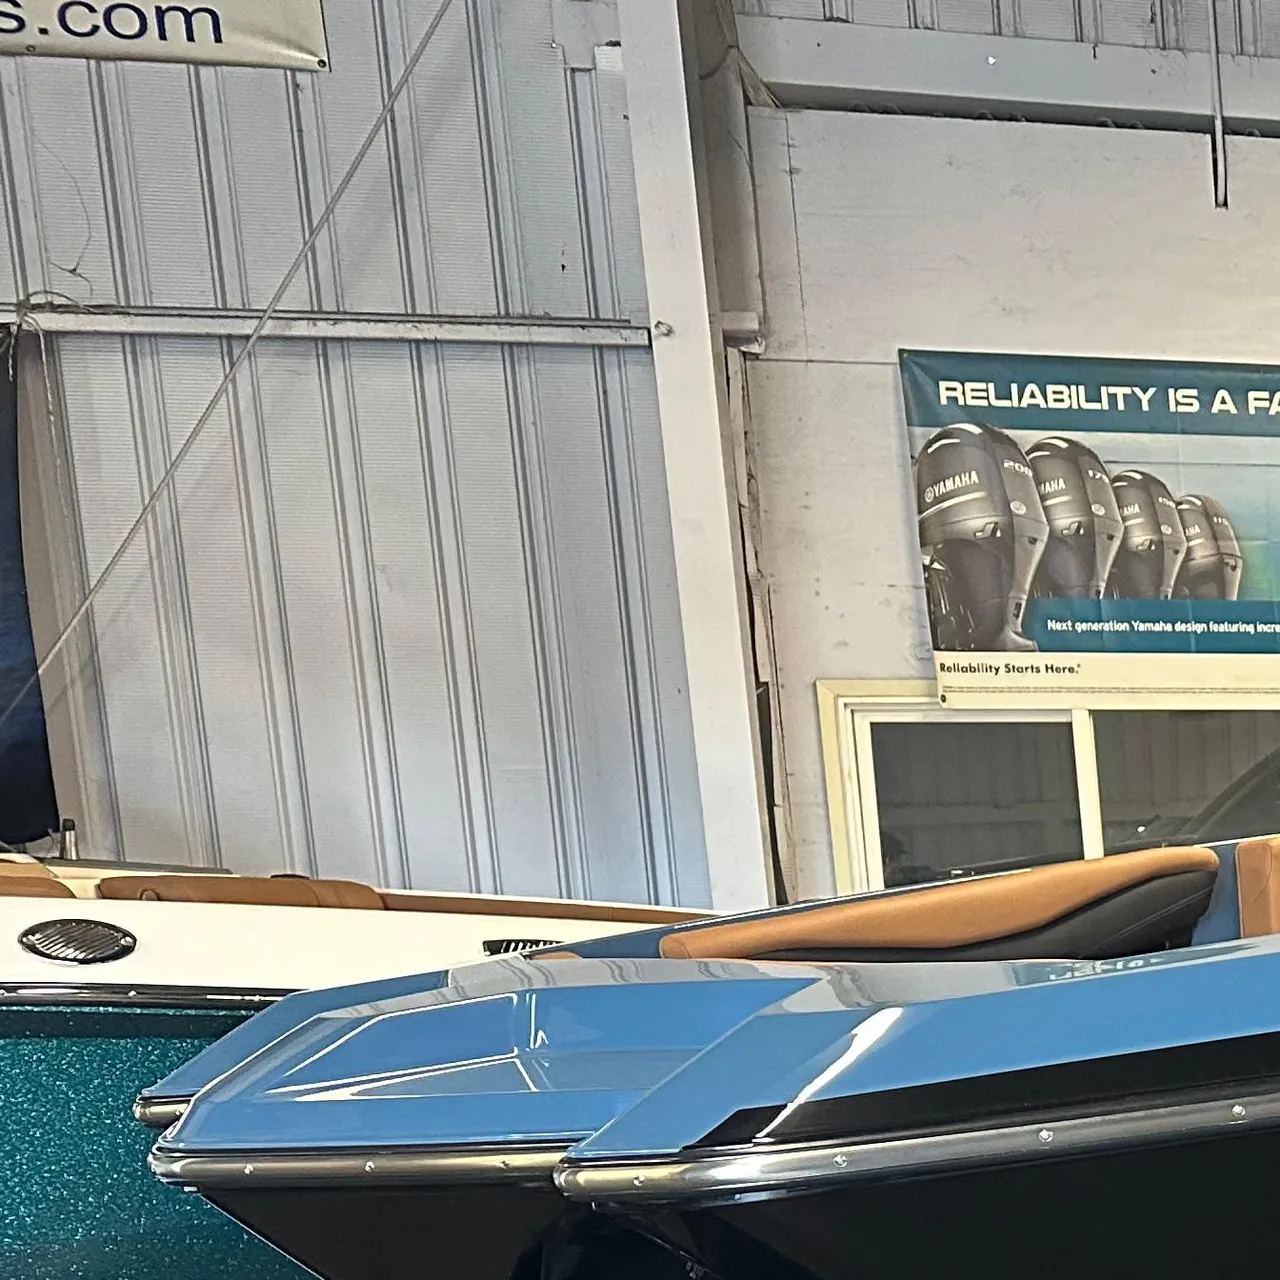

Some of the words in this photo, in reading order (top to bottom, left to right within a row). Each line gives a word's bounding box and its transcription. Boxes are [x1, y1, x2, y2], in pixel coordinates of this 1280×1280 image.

[938, 381, 1157, 412] RELIABILITY
[1168, 387, 1200, 413] IS
[1211, 389, 1238, 414] A
[933, 470, 979, 497] YAMAHA
[1047, 619, 1072, 632] Next
[1074, 619, 1130, 634] generation
[1131, 620, 1173, 633] Yamaha
[1175, 620, 1207, 635] design
[1209, 620, 1255, 635] featuring
[939, 662, 1000, 676] Reliability
[1004, 663, 1042, 675] Starts
